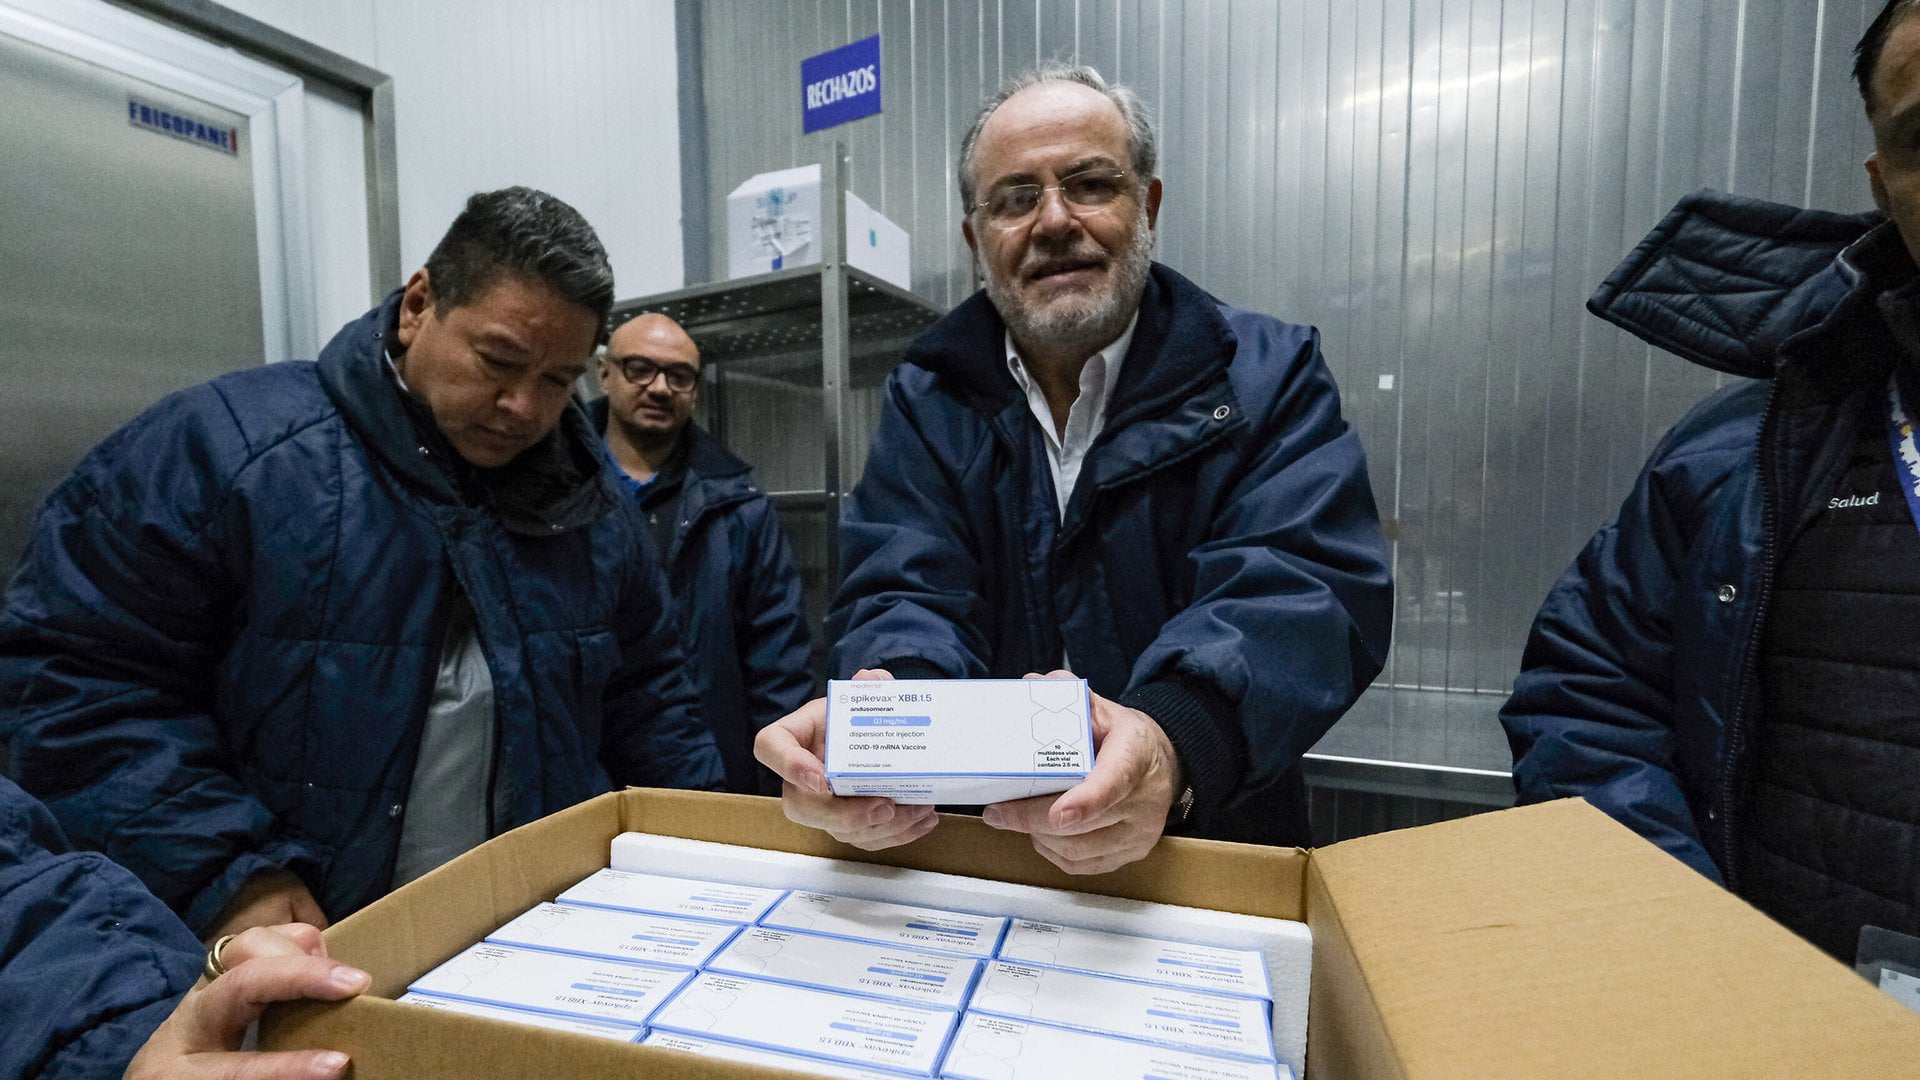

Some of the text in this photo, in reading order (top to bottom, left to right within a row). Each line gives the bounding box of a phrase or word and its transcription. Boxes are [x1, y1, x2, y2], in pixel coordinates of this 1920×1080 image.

[807, 64, 876, 110] RECHAZOS
[1828, 491, 1880, 509] Salud
[898, 694, 932, 702] XBB.1.5
[849, 731, 884, 739] dispersion
[896, 731, 925, 739] injection
